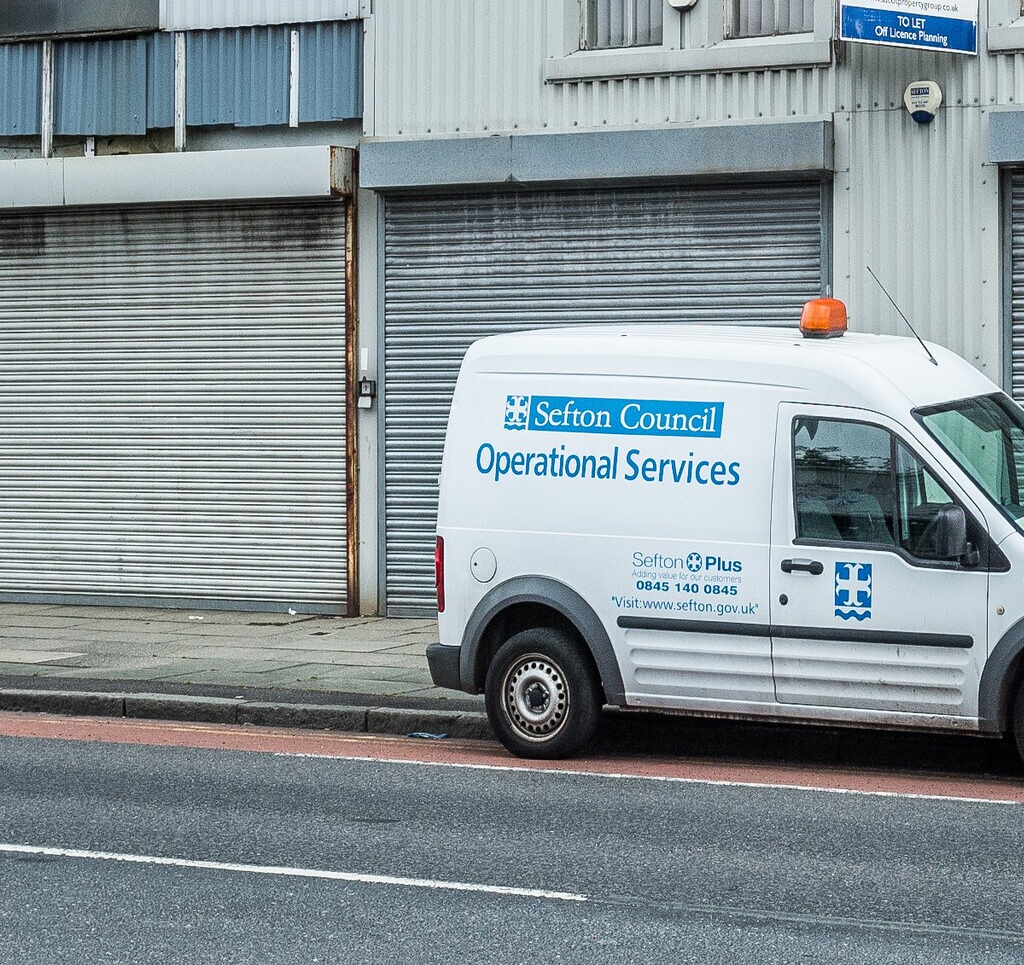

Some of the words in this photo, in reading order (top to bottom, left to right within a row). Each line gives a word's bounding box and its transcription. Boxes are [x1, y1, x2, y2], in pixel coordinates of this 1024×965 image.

[897, 15, 910, 28] TO
[911, 17, 926, 29] LET
[874, 25, 888, 36] Off
[889, 29, 917, 41] Licence
[918, 31, 948, 47] Planning
[534, 400, 612, 428] Sefton
[620, 403, 716, 433] Council
[476, 442, 619, 482] Operational
[624, 448, 741, 486] Services
[632, 551, 684, 569] Sefton
[705, 556, 743, 572] Plus
[632, 570, 657, 580] Adding
[658, 572, 678, 580] value
[678, 572, 689, 581] for
[703, 574, 742, 584] customers
[636, 580, 669, 592] 0845
[675, 582, 699, 594] 140
[703, 583, 738, 596] 0845
